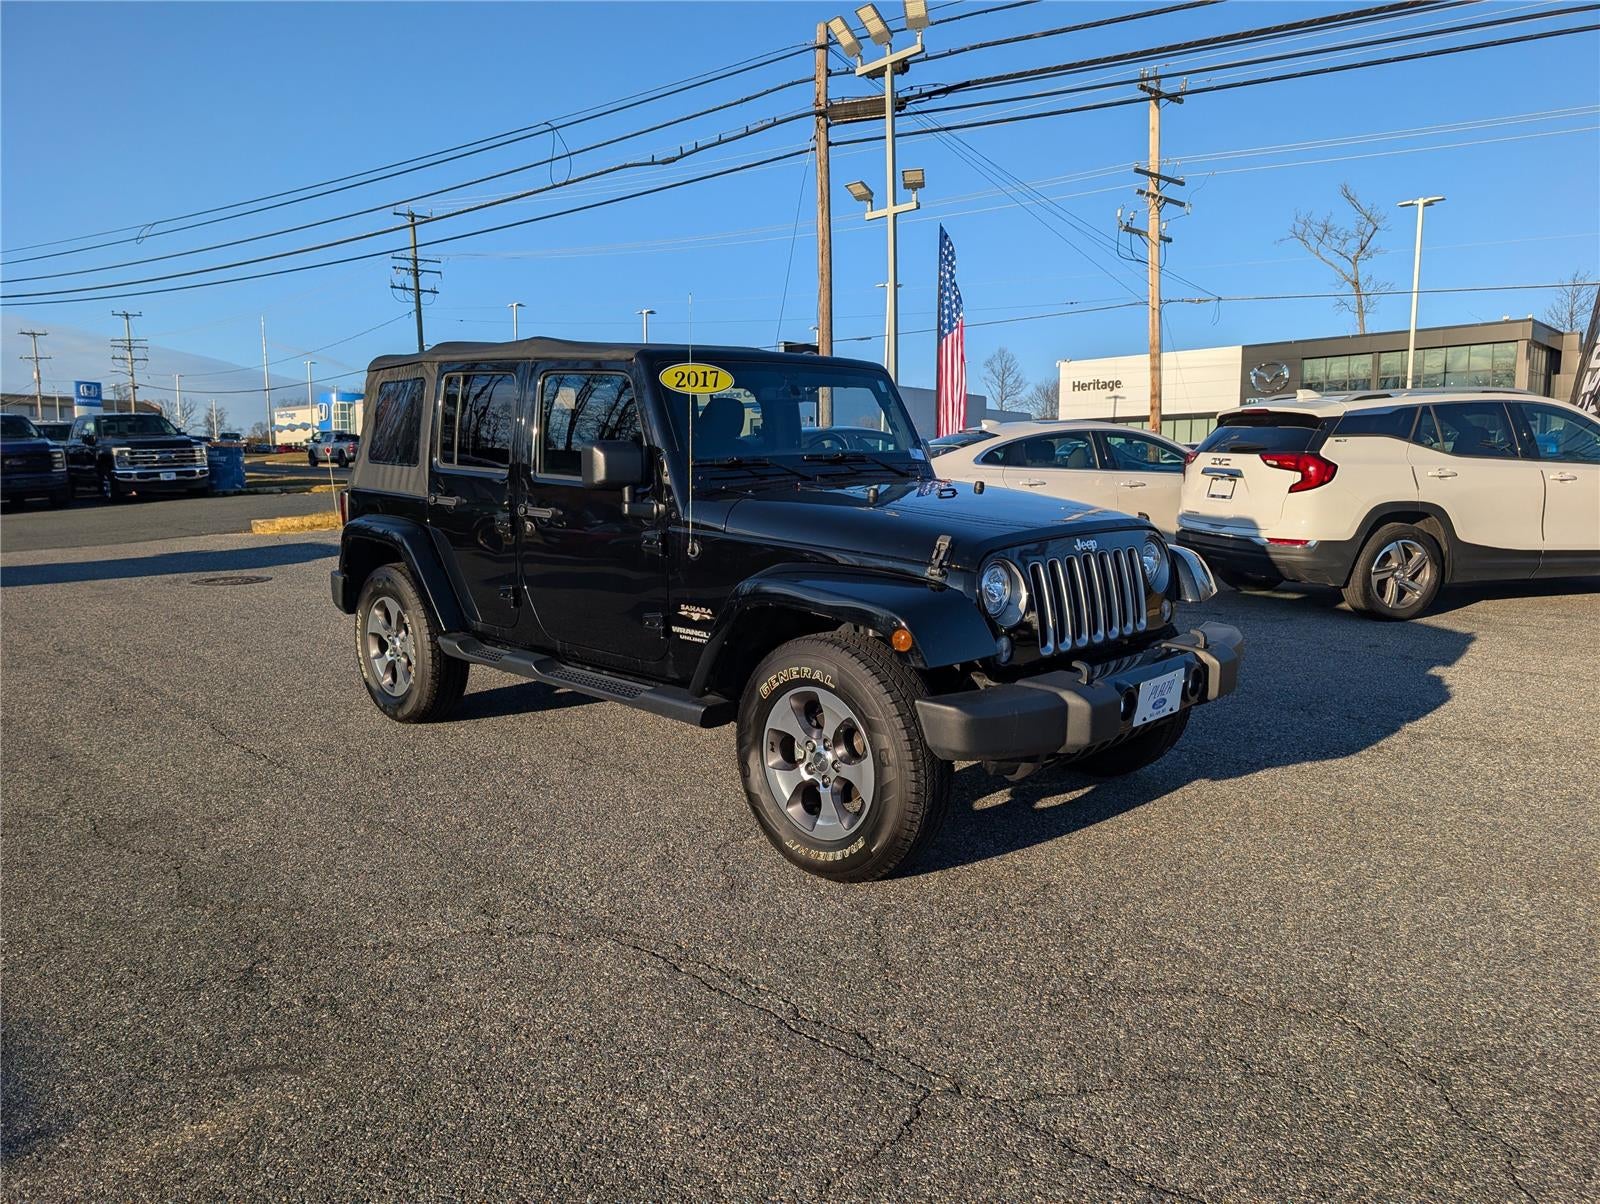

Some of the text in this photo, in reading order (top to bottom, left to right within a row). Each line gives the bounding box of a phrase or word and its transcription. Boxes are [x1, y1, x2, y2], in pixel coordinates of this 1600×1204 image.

[674, 371, 719, 389] 2017
[1073, 538, 1098, 552] Jeep
[680, 604, 713, 615] SAHARA
[759, 666, 836, 700] GENERAL
